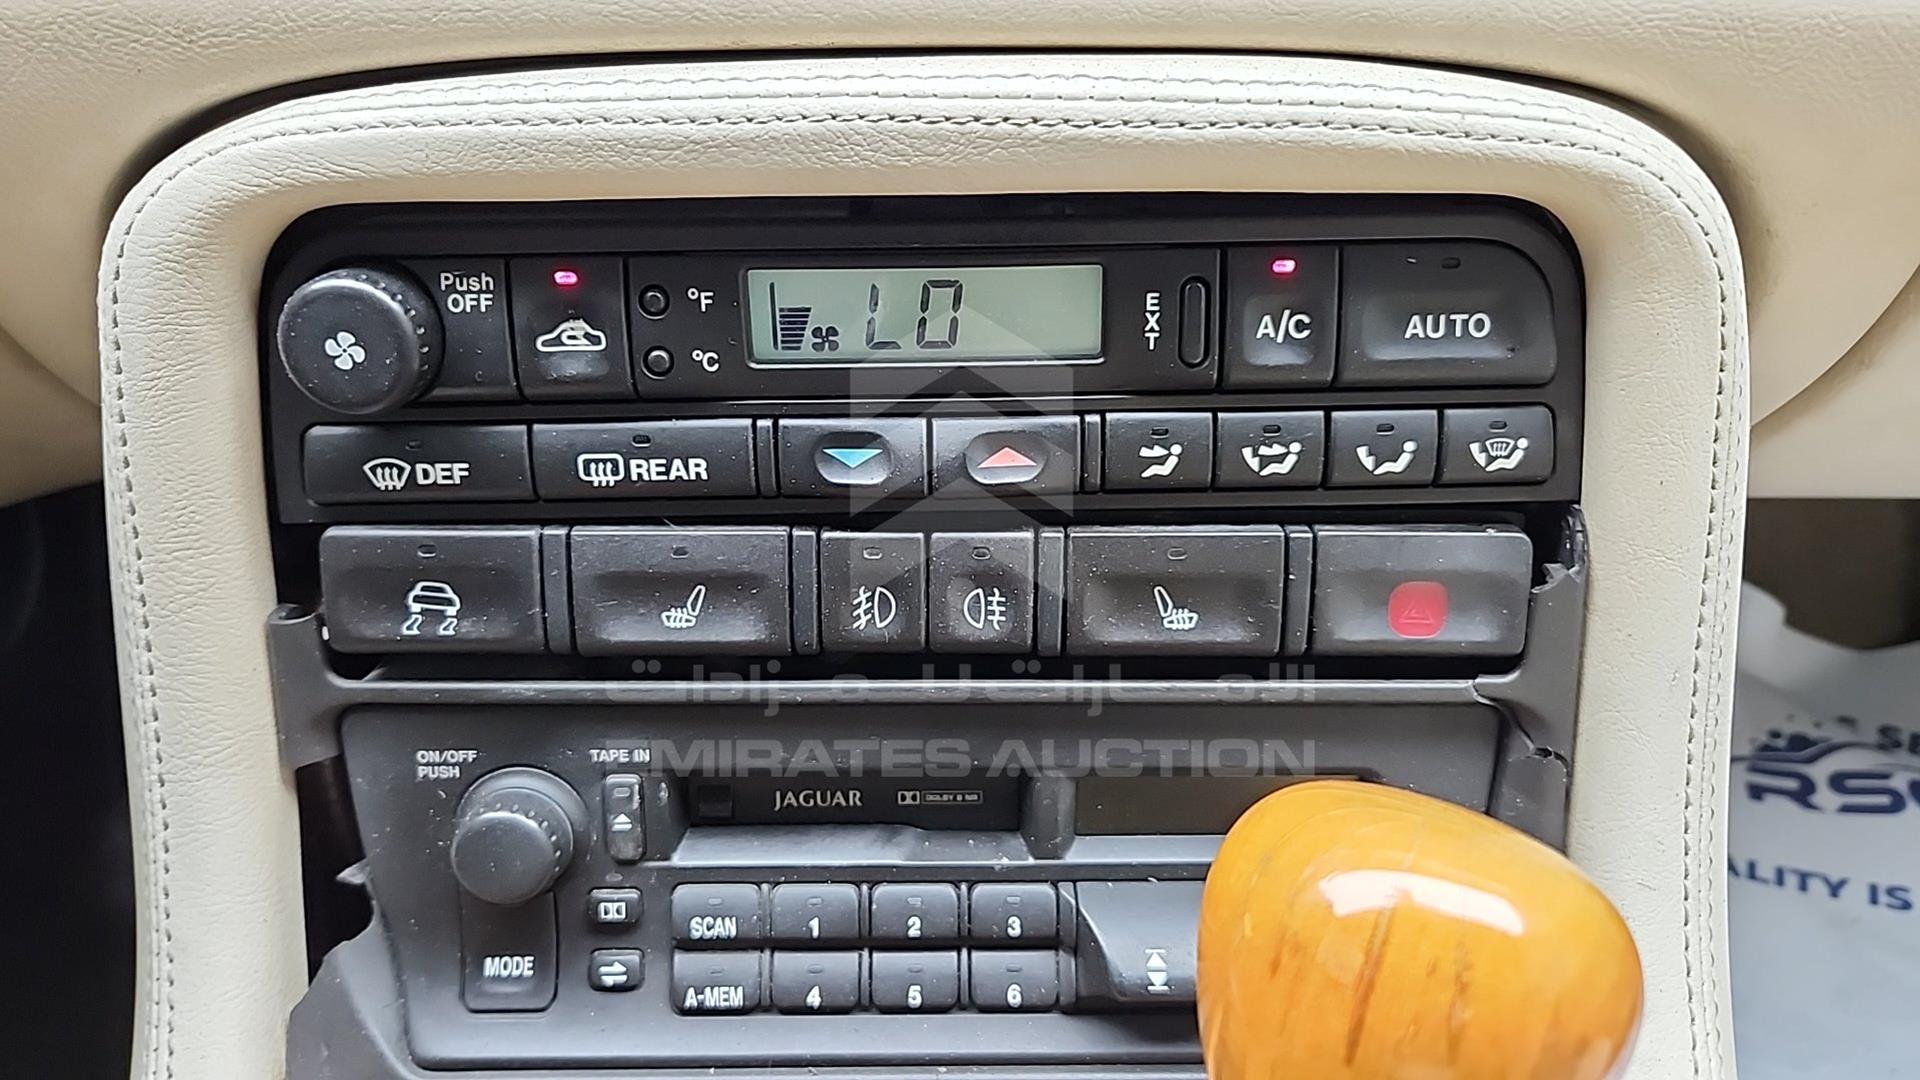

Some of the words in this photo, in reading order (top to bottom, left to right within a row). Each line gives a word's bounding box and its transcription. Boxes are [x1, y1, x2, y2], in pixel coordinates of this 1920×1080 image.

[439, 270, 495, 292] Push
[446, 293, 494, 314] OFF
[1144, 292, 1161, 350] EXT
[1255, 313, 1313, 344] A/C
[1404, 312, 1492, 340] AUTO
[415, 462, 470, 486] DEF
[629, 457, 709, 482] REAR
[416, 750, 477, 764] ON/OFF
[590, 749, 629, 763] TAPE
[632, 749, 650, 763] IN
[417, 765, 460, 779] PUSH
[774, 789, 863, 811] JAGUAR
[1868, 882, 1912, 910] IS
[689, 917, 737, 939] SCAN
[807, 916, 819, 938] 1
[907, 917, 921, 938] 2
[1007, 917, 1022, 938] 3
[483, 956, 535, 978] MODE
[684, 986, 743, 1009] A-MEM
[805, 985, 821, 1008] 4
[907, 984, 922, 1007] 5
[1007, 984, 1022, 1007] 6
